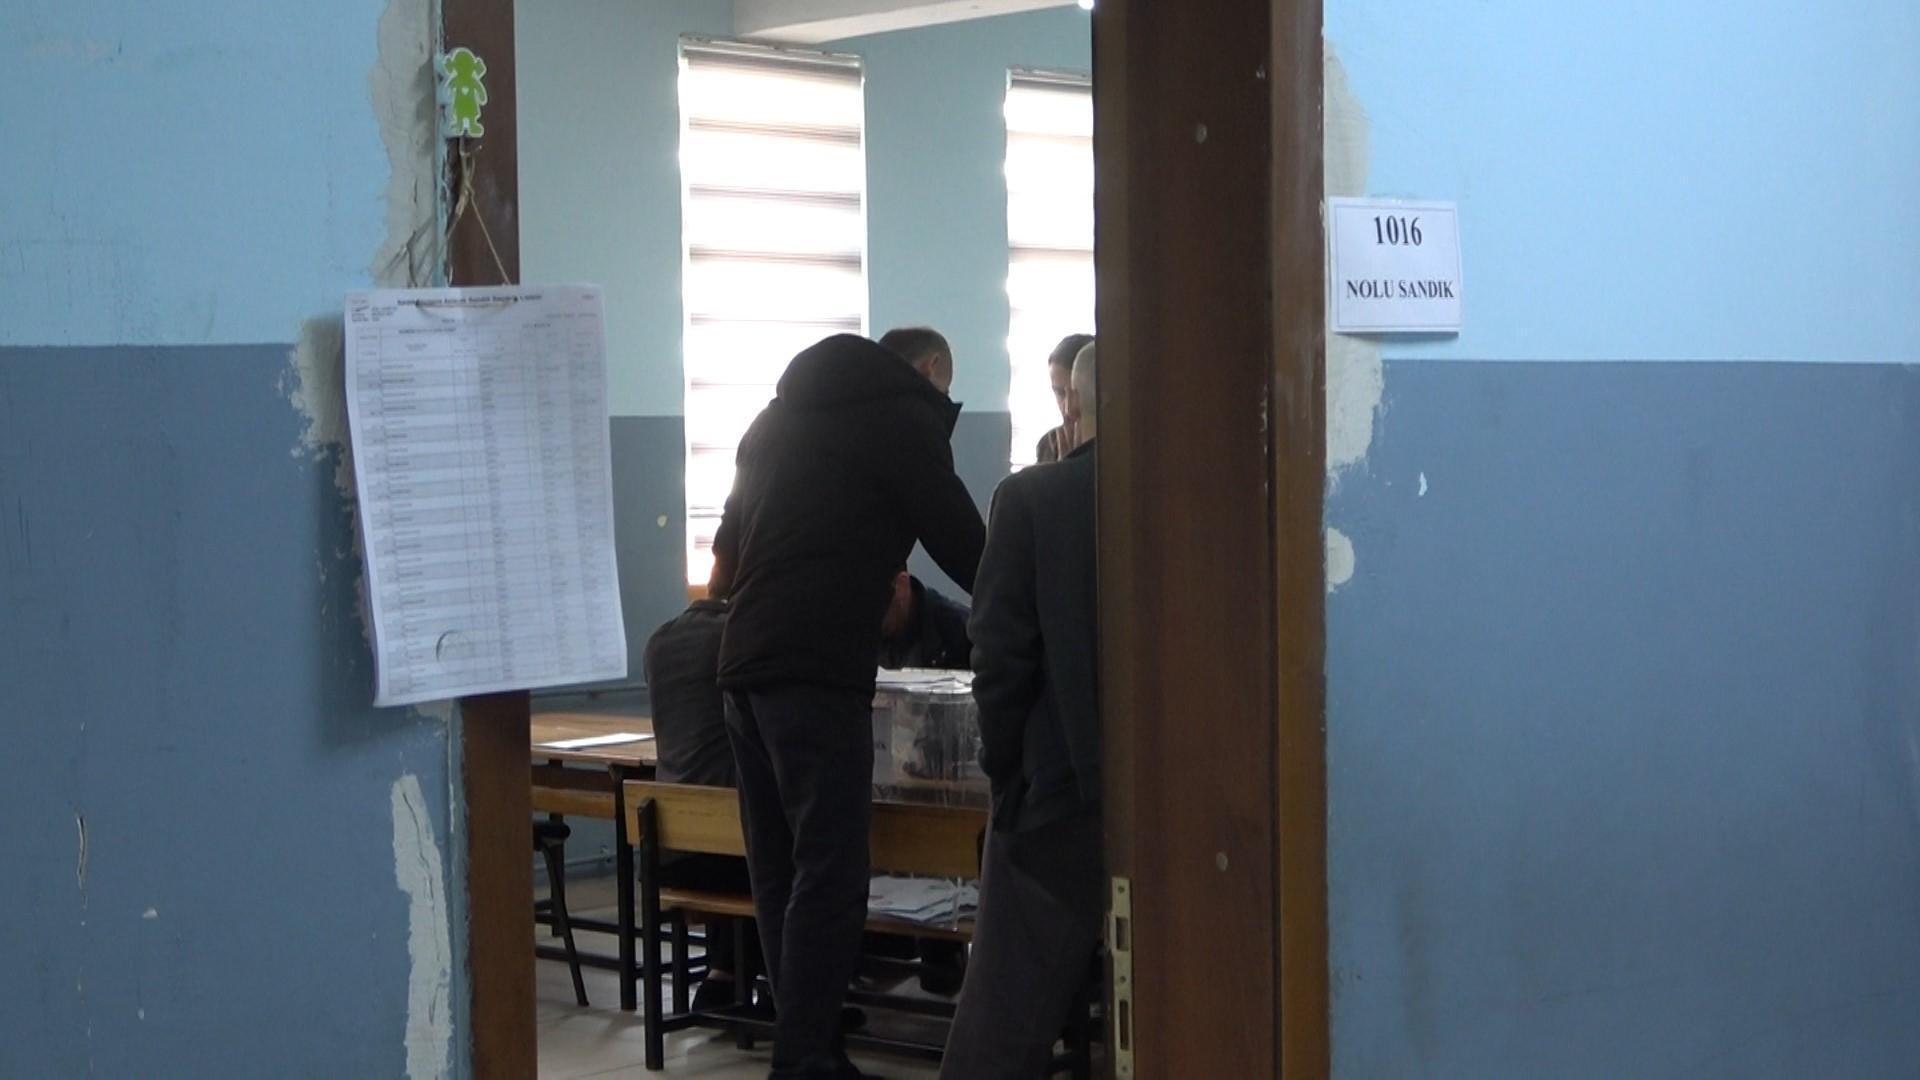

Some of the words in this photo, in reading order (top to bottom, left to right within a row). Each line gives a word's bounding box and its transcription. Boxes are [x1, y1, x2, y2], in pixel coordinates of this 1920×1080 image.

[1374, 215, 1422, 246] 1016
[1346, 279, 1394, 299] NOLU
[1398, 279, 1454, 299] SANDIK
